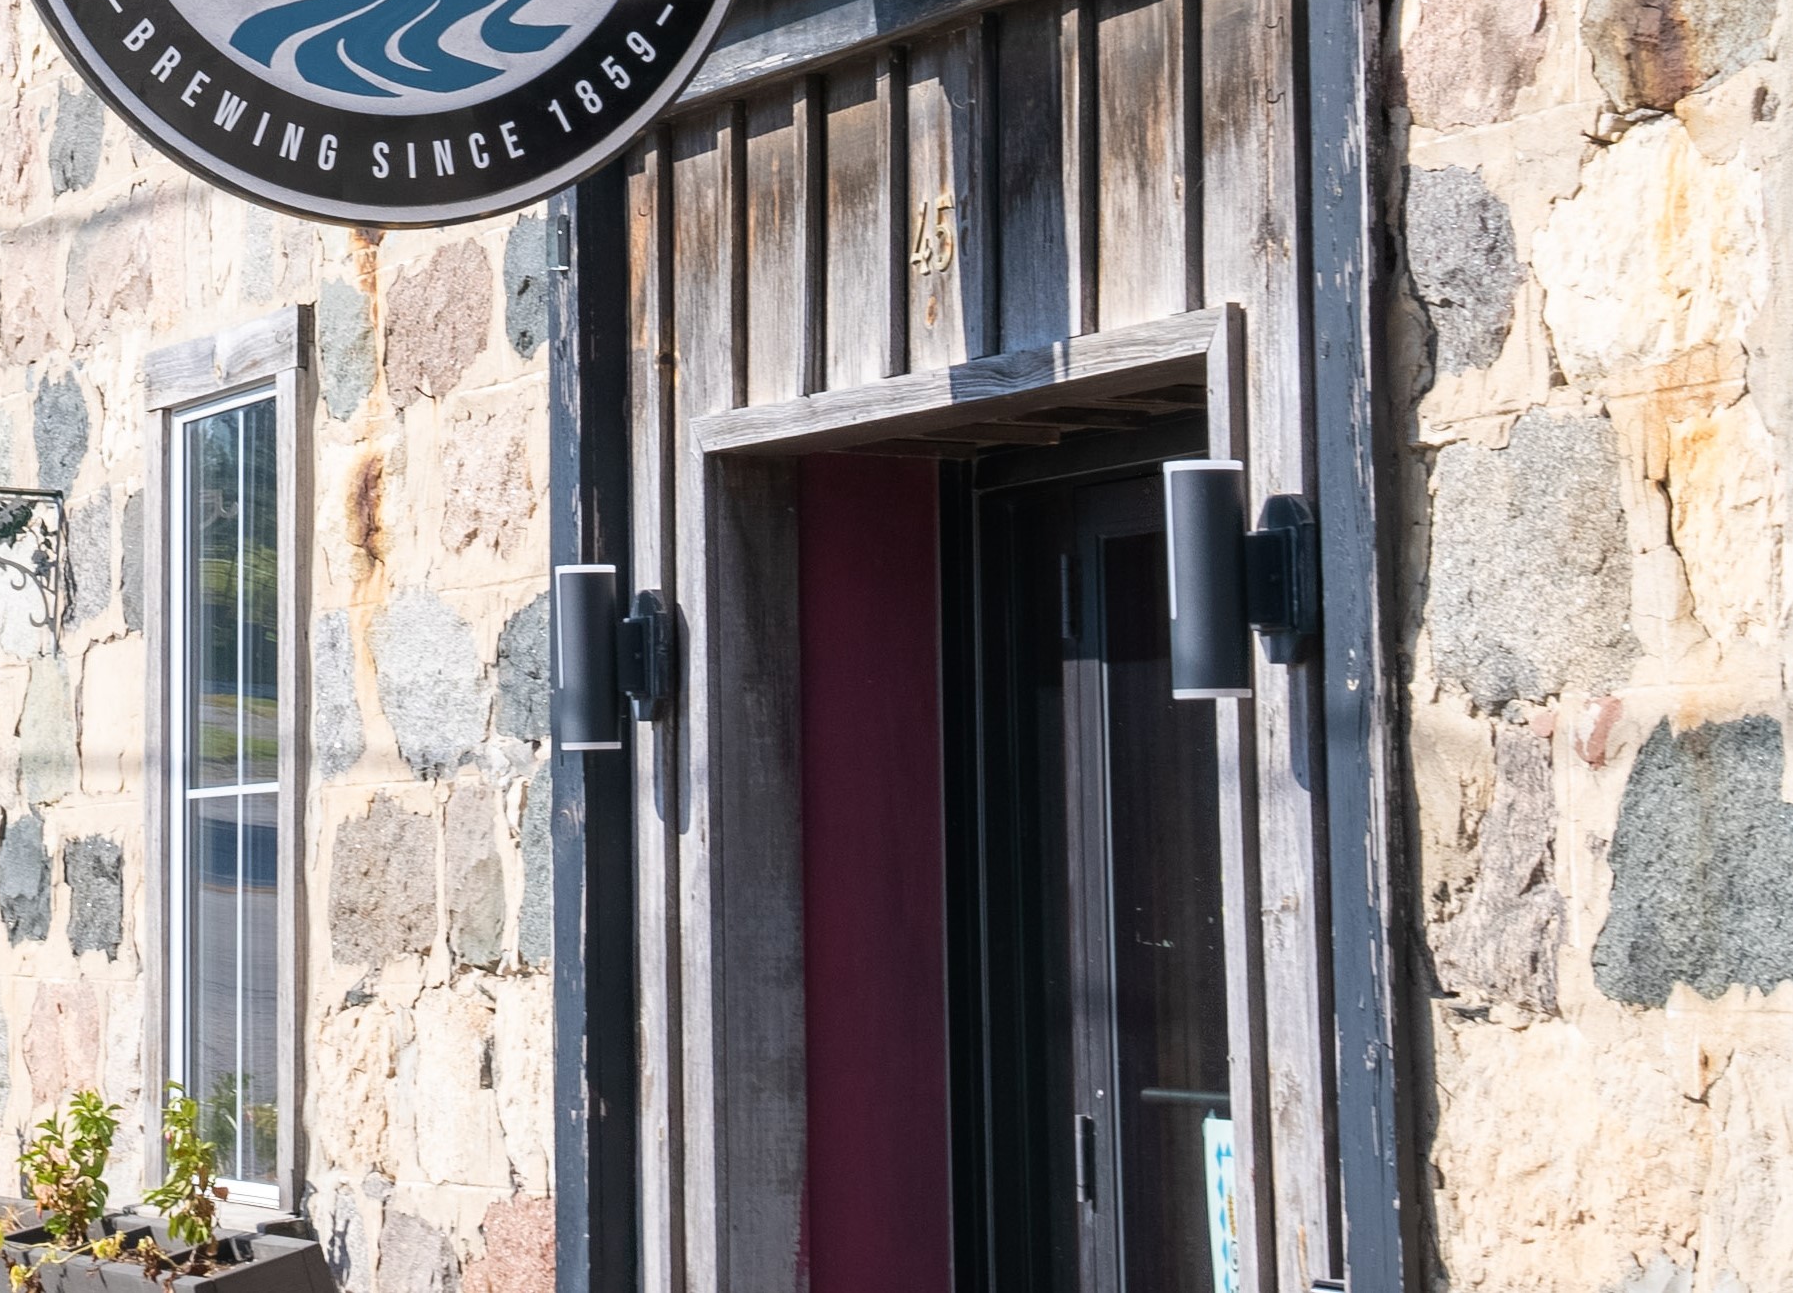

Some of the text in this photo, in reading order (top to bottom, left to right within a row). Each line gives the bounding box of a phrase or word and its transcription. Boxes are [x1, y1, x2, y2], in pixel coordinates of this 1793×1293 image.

[122, 17, 658, 180] BREWING SINCE 1859
[909, 191, 956, 277] 45
